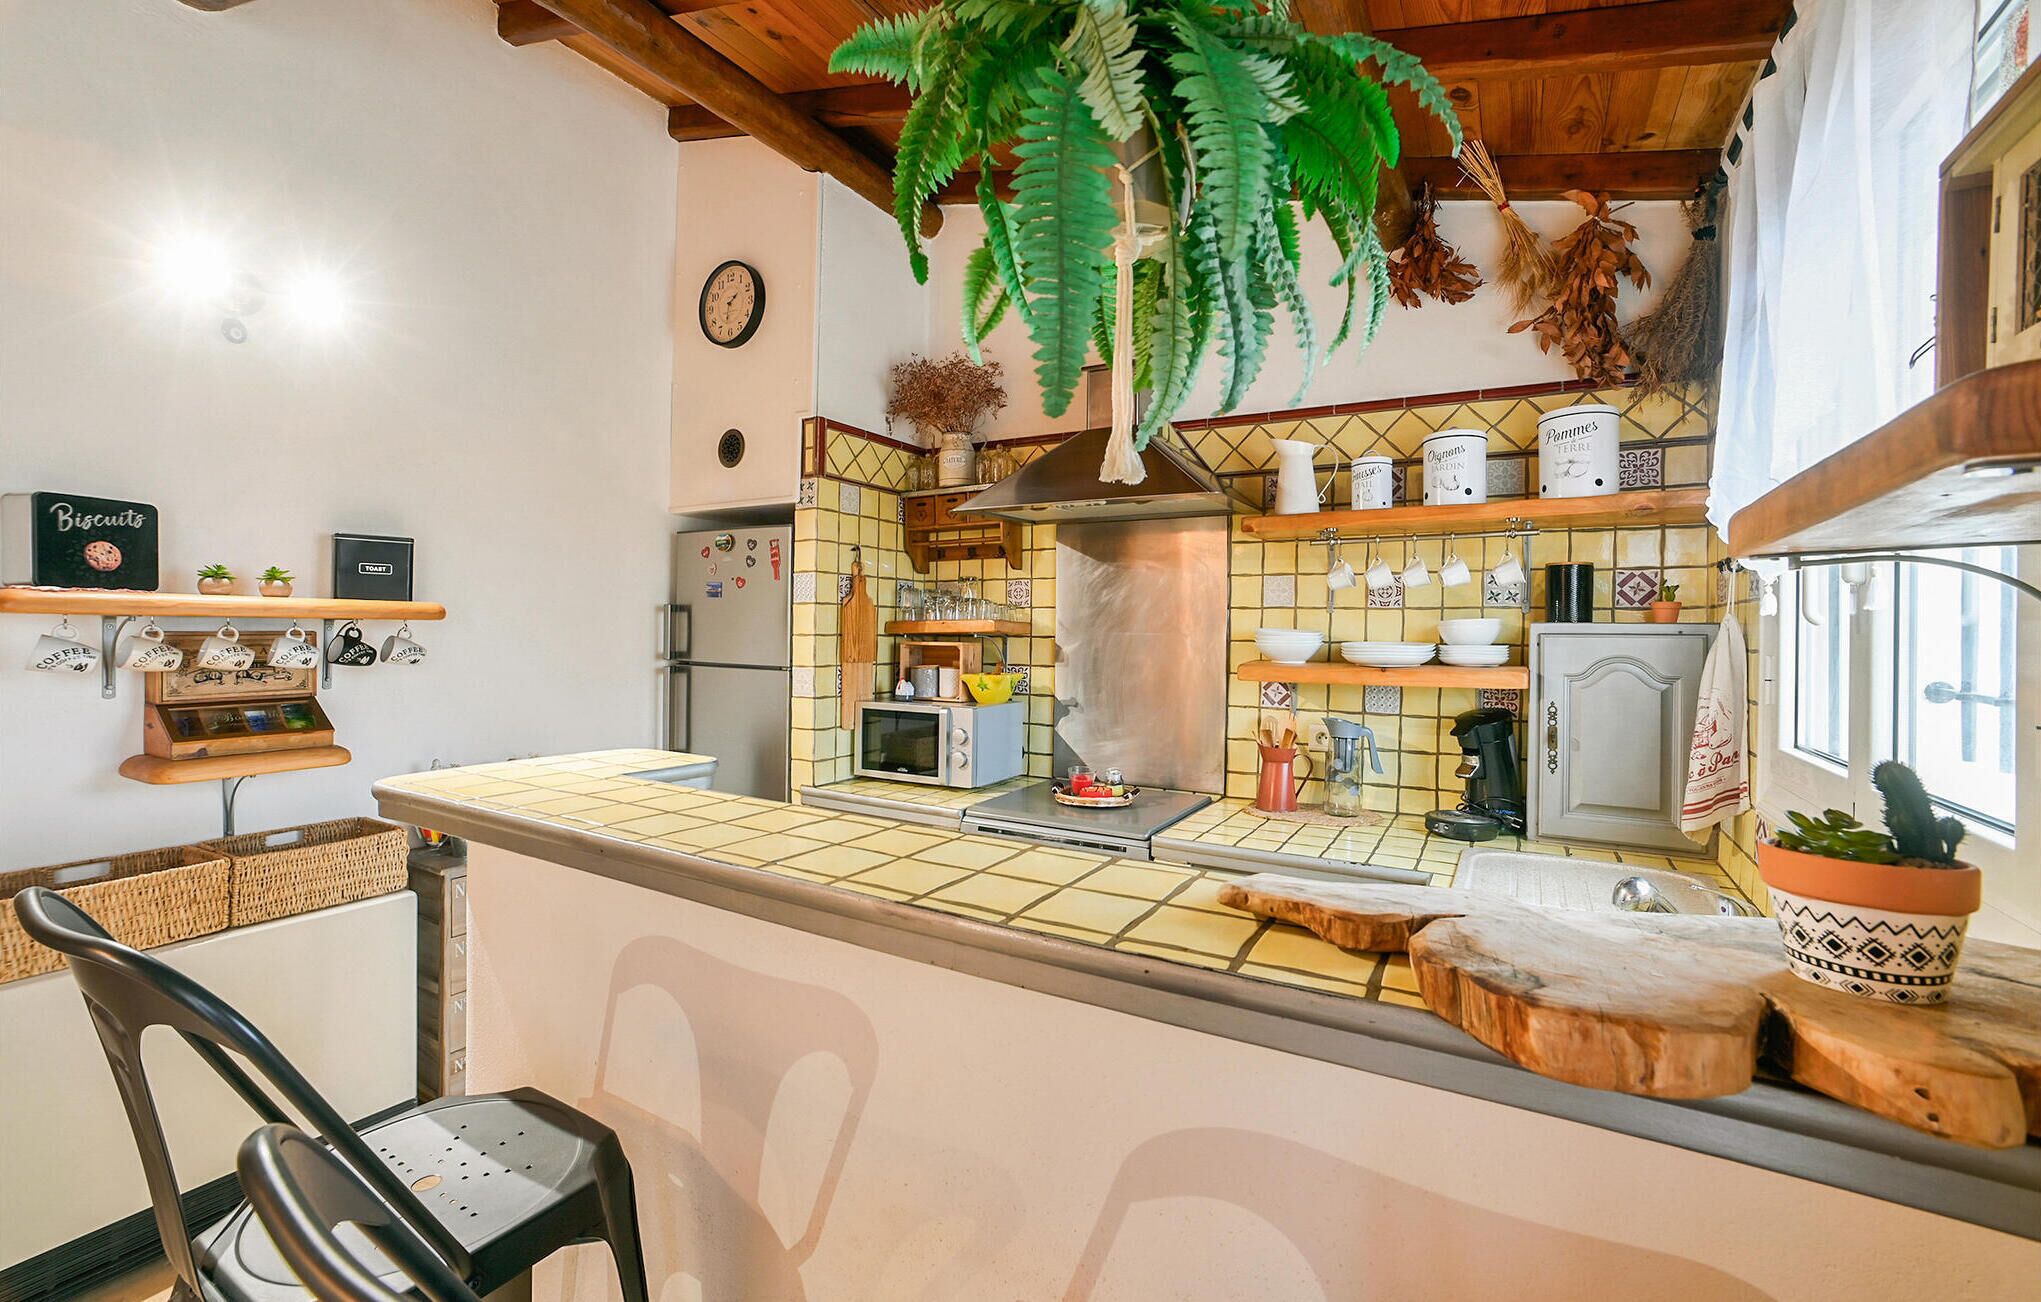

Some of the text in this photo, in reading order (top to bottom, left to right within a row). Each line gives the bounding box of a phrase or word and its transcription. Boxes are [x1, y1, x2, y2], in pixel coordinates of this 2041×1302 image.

[718, 280, 725, 290] 11
[727, 272, 735, 283] 12
[745, 282, 751, 293] 2
[711, 292, 720, 303] 10
[747, 295, 754, 305] 3
[727, 327, 733, 337] 6
[1545, 421, 1599, 446] Pommes
[1427, 444, 1466, 464] Oignons
[1553, 442, 1593, 454] TERRE
[49, 502, 148, 532] Biscuits
[36, 647, 91, 670] COFFEE
[131, 645, 176, 669] COFFEE
[206, 645, 248, 666] COFFEE
[275, 645, 313, 666] COFFEE
[338, 643, 370, 663] COFFEE
[390, 646, 425, 662] COFFEE
